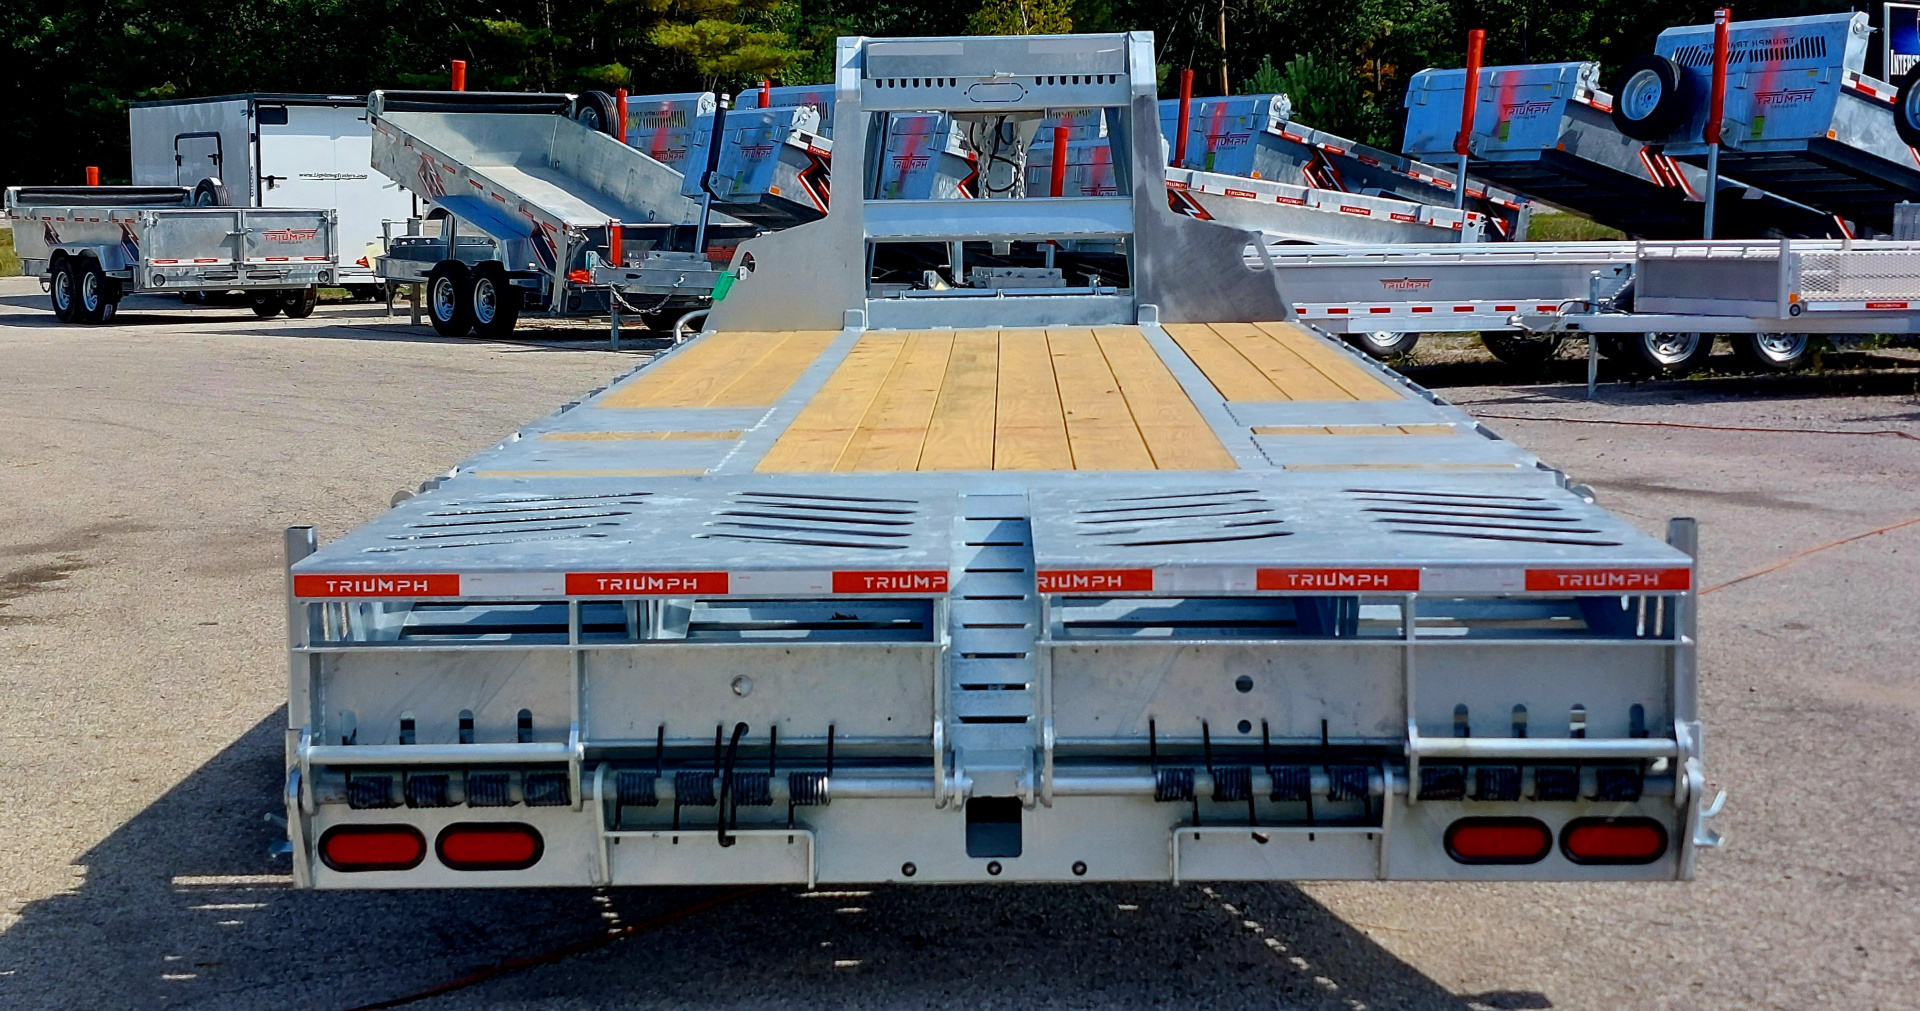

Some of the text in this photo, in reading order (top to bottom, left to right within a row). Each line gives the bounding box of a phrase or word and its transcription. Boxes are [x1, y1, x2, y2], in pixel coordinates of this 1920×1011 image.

[1757, 93, 1813, 105] TRIUMPH
[1503, 105, 1550, 116] TRIUMPH
[1207, 137, 1248, 147] TRIUMPH
[741, 149, 771, 158] TRIUMPH
[893, 160, 928, 170] TRIUMPH
[264, 233, 315, 242] TRIUMPH
[1382, 281, 1430, 290] TRIUMPH
[326, 578, 428, 592] TRIUMPH
[597, 576, 698, 591] TRIUMPH
[863, 575, 947, 589] TRIUMP
[1037, 574, 1123, 588] RIUMPH
[1288, 572, 1389, 586] TRIUMPH
[1557, 572, 1660, 586] TRIUMPH
